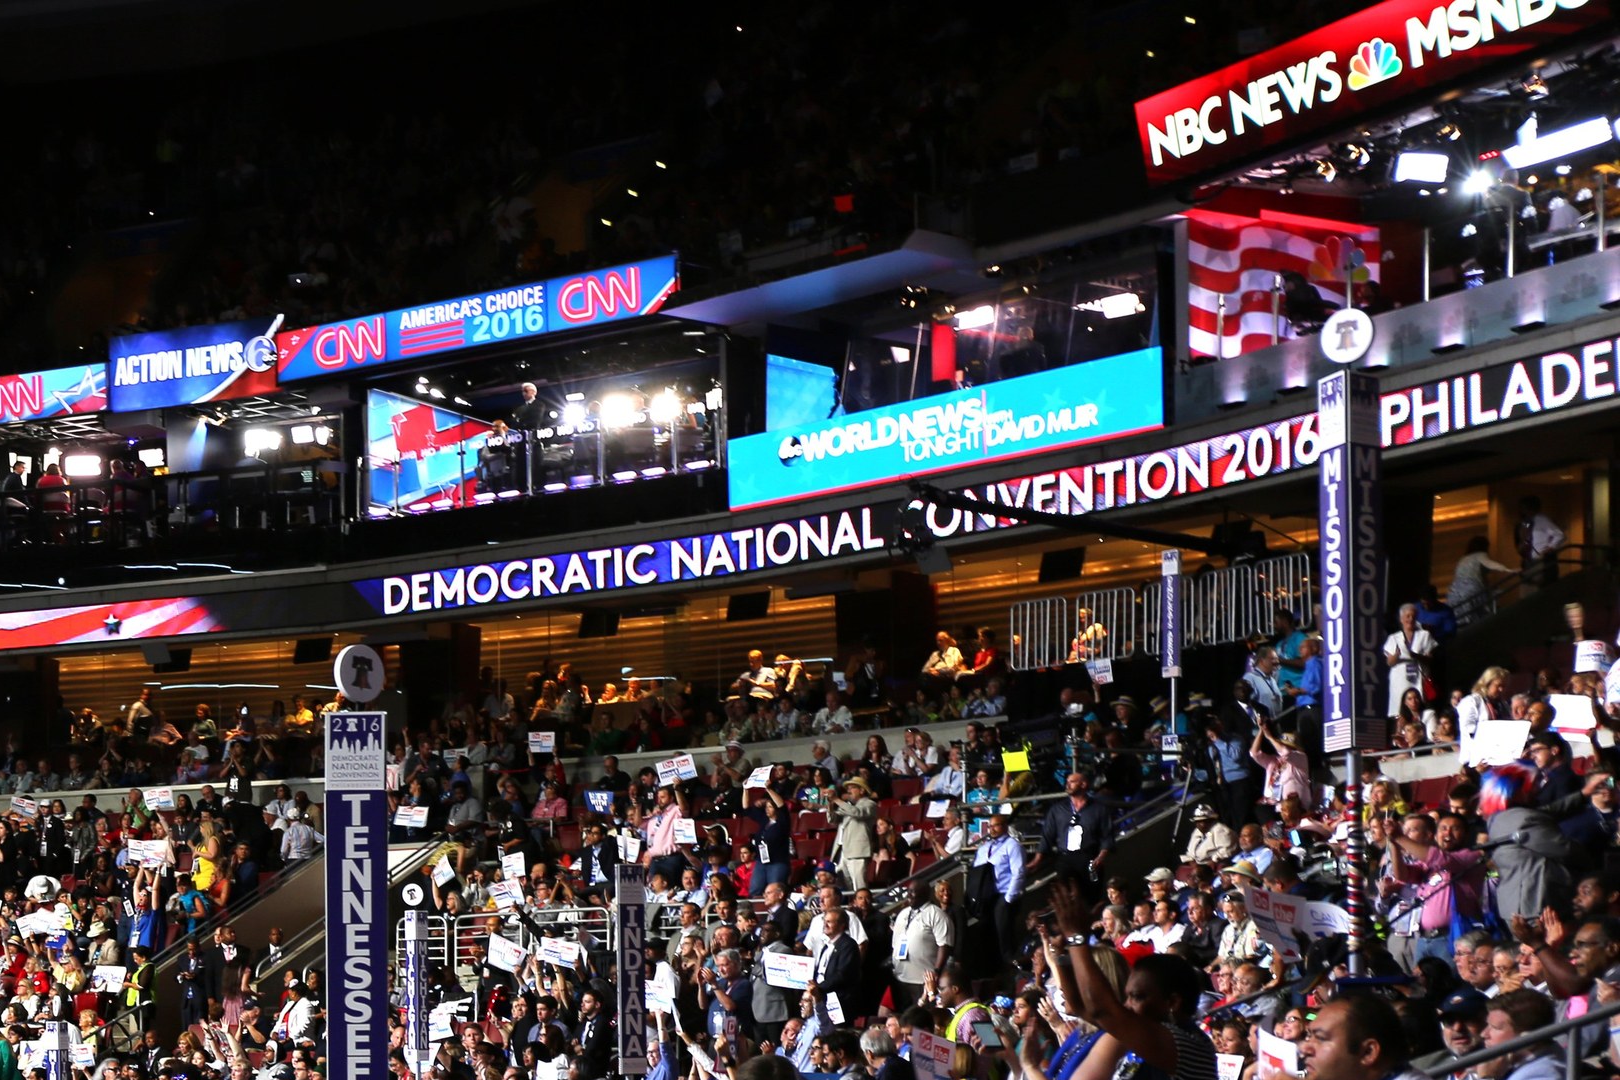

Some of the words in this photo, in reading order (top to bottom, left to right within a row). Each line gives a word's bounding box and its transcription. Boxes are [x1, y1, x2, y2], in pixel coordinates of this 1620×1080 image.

[1147, 95, 1228, 167] NBC
[1228, 50, 1343, 137] NEWS
[399, 298, 482, 330] AMERICA'S
[485, 285, 544, 313] CHOICE
[473, 305, 544, 343] 2016
[558, 266, 641, 323] CNN
[113, 350, 182, 387] ACTION
[185, 341, 245, 377] NEWS
[313, 314, 386, 369] CNN
[985, 414, 1047, 447] DAVID
[1046, 402, 1099, 433] MUIR
[1380, 336, 1620, 449] PHILADE
[800, 415, 899, 462] WORLD
[898, 397, 982, 441] NEWS
[900, 430, 980, 463] TONIGHT
[383, 543, 656, 616] DEMOCRATIC
[671, 506, 884, 582] NATIONAL
[909, 451, 1209, 537] ONVENTION
[1223, 413, 1321, 485] 2016
[1323, 448, 1345, 720] MISSOURI
[1355, 448, 1379, 716] MISSOURI
[331, 762, 378, 770] NATIONAL
[406, 940, 416, 1049] MICHIGAN
[419, 941, 427, 1049] MICHIGAN
[624, 905, 643, 1057] INDIANA
